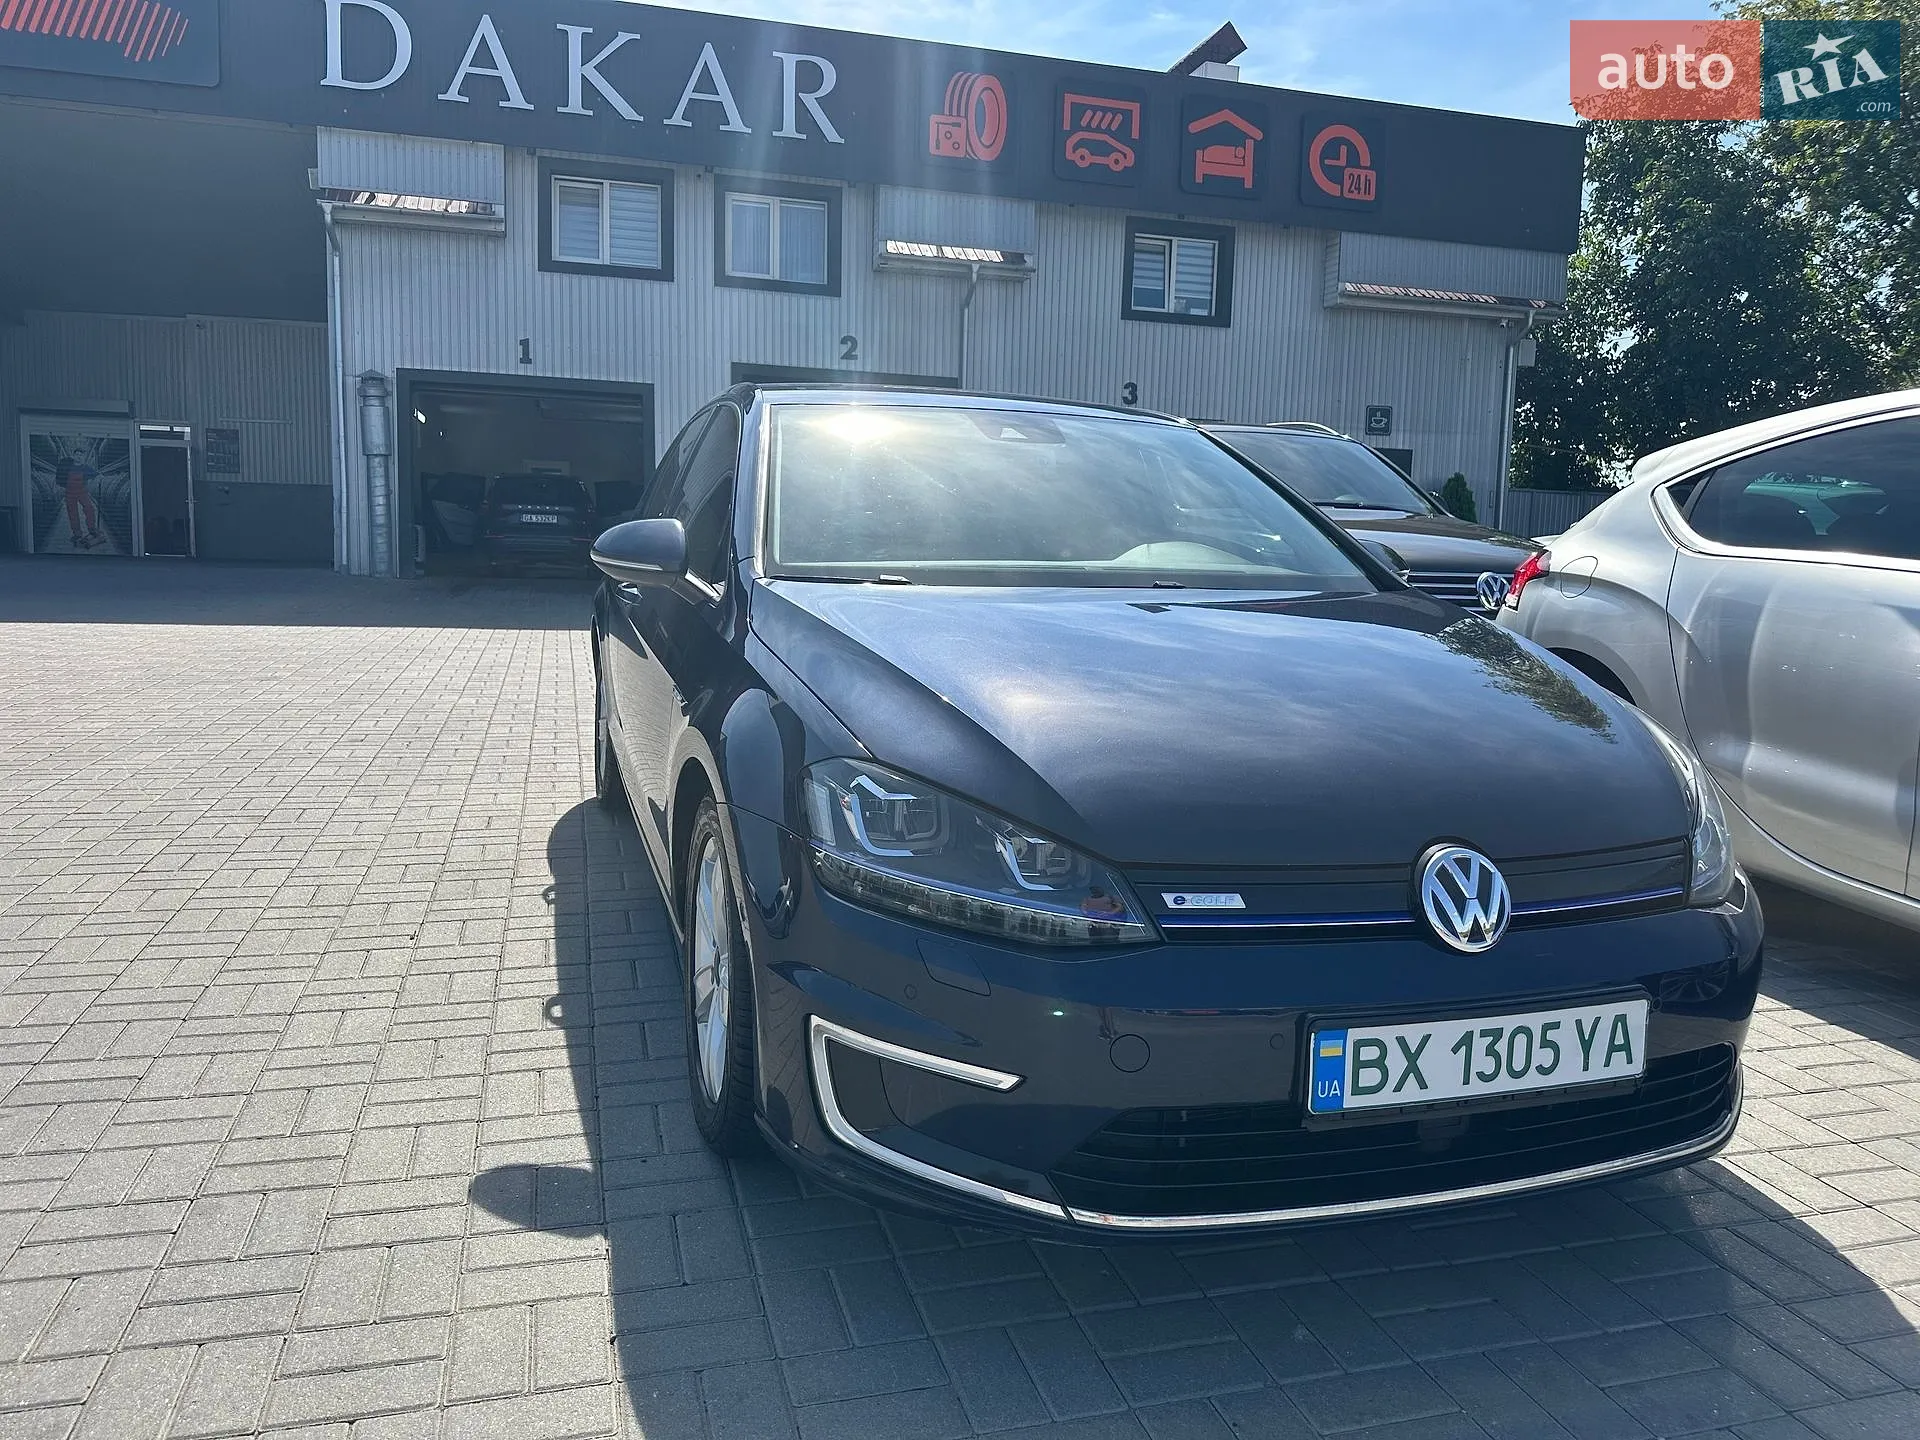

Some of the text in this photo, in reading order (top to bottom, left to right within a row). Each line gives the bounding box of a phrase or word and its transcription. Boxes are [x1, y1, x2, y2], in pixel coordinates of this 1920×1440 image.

[320, 0, 845, 144] DAKAR
[1348, 172, 1362, 195] 24
[519, 338, 533, 364] 1
[839, 335, 859, 360] 2
[1122, 382, 1138, 405] 3
[1351, 1013, 1634, 1097] BX 1305 YA
[1317, 1079, 1342, 1098] UA
